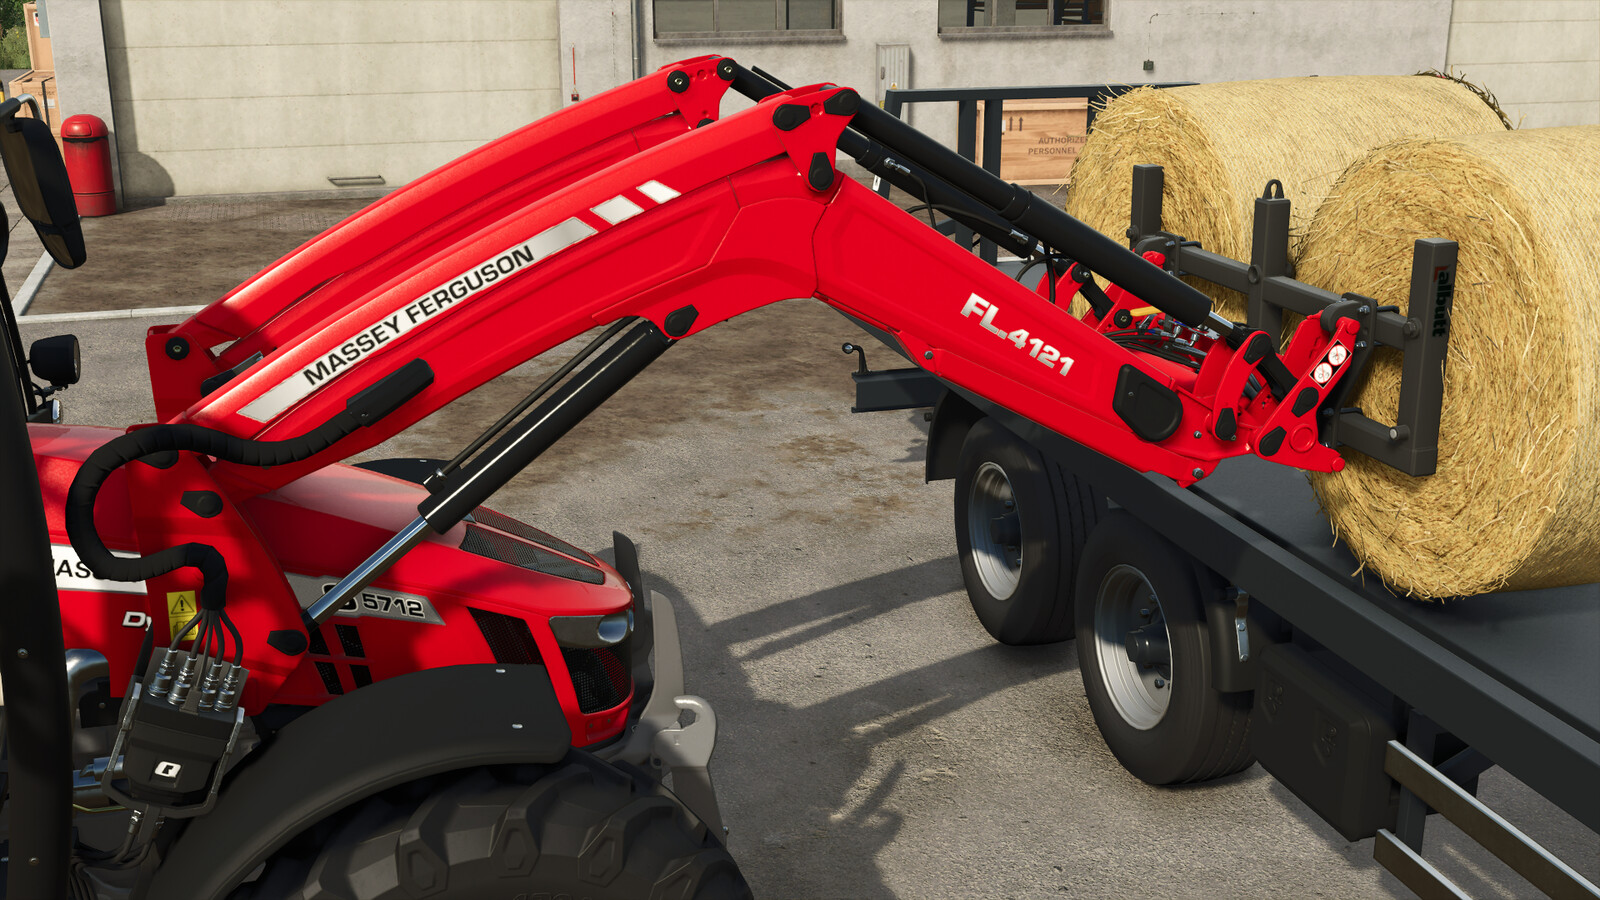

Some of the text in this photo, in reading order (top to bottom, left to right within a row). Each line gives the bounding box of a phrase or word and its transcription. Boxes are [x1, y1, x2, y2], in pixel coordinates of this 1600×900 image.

[1028, 147, 1077, 155] PERSONNEL
[303, 245, 534, 386] MASSEY FERGUSON
[361, 592, 425, 619] 5712
